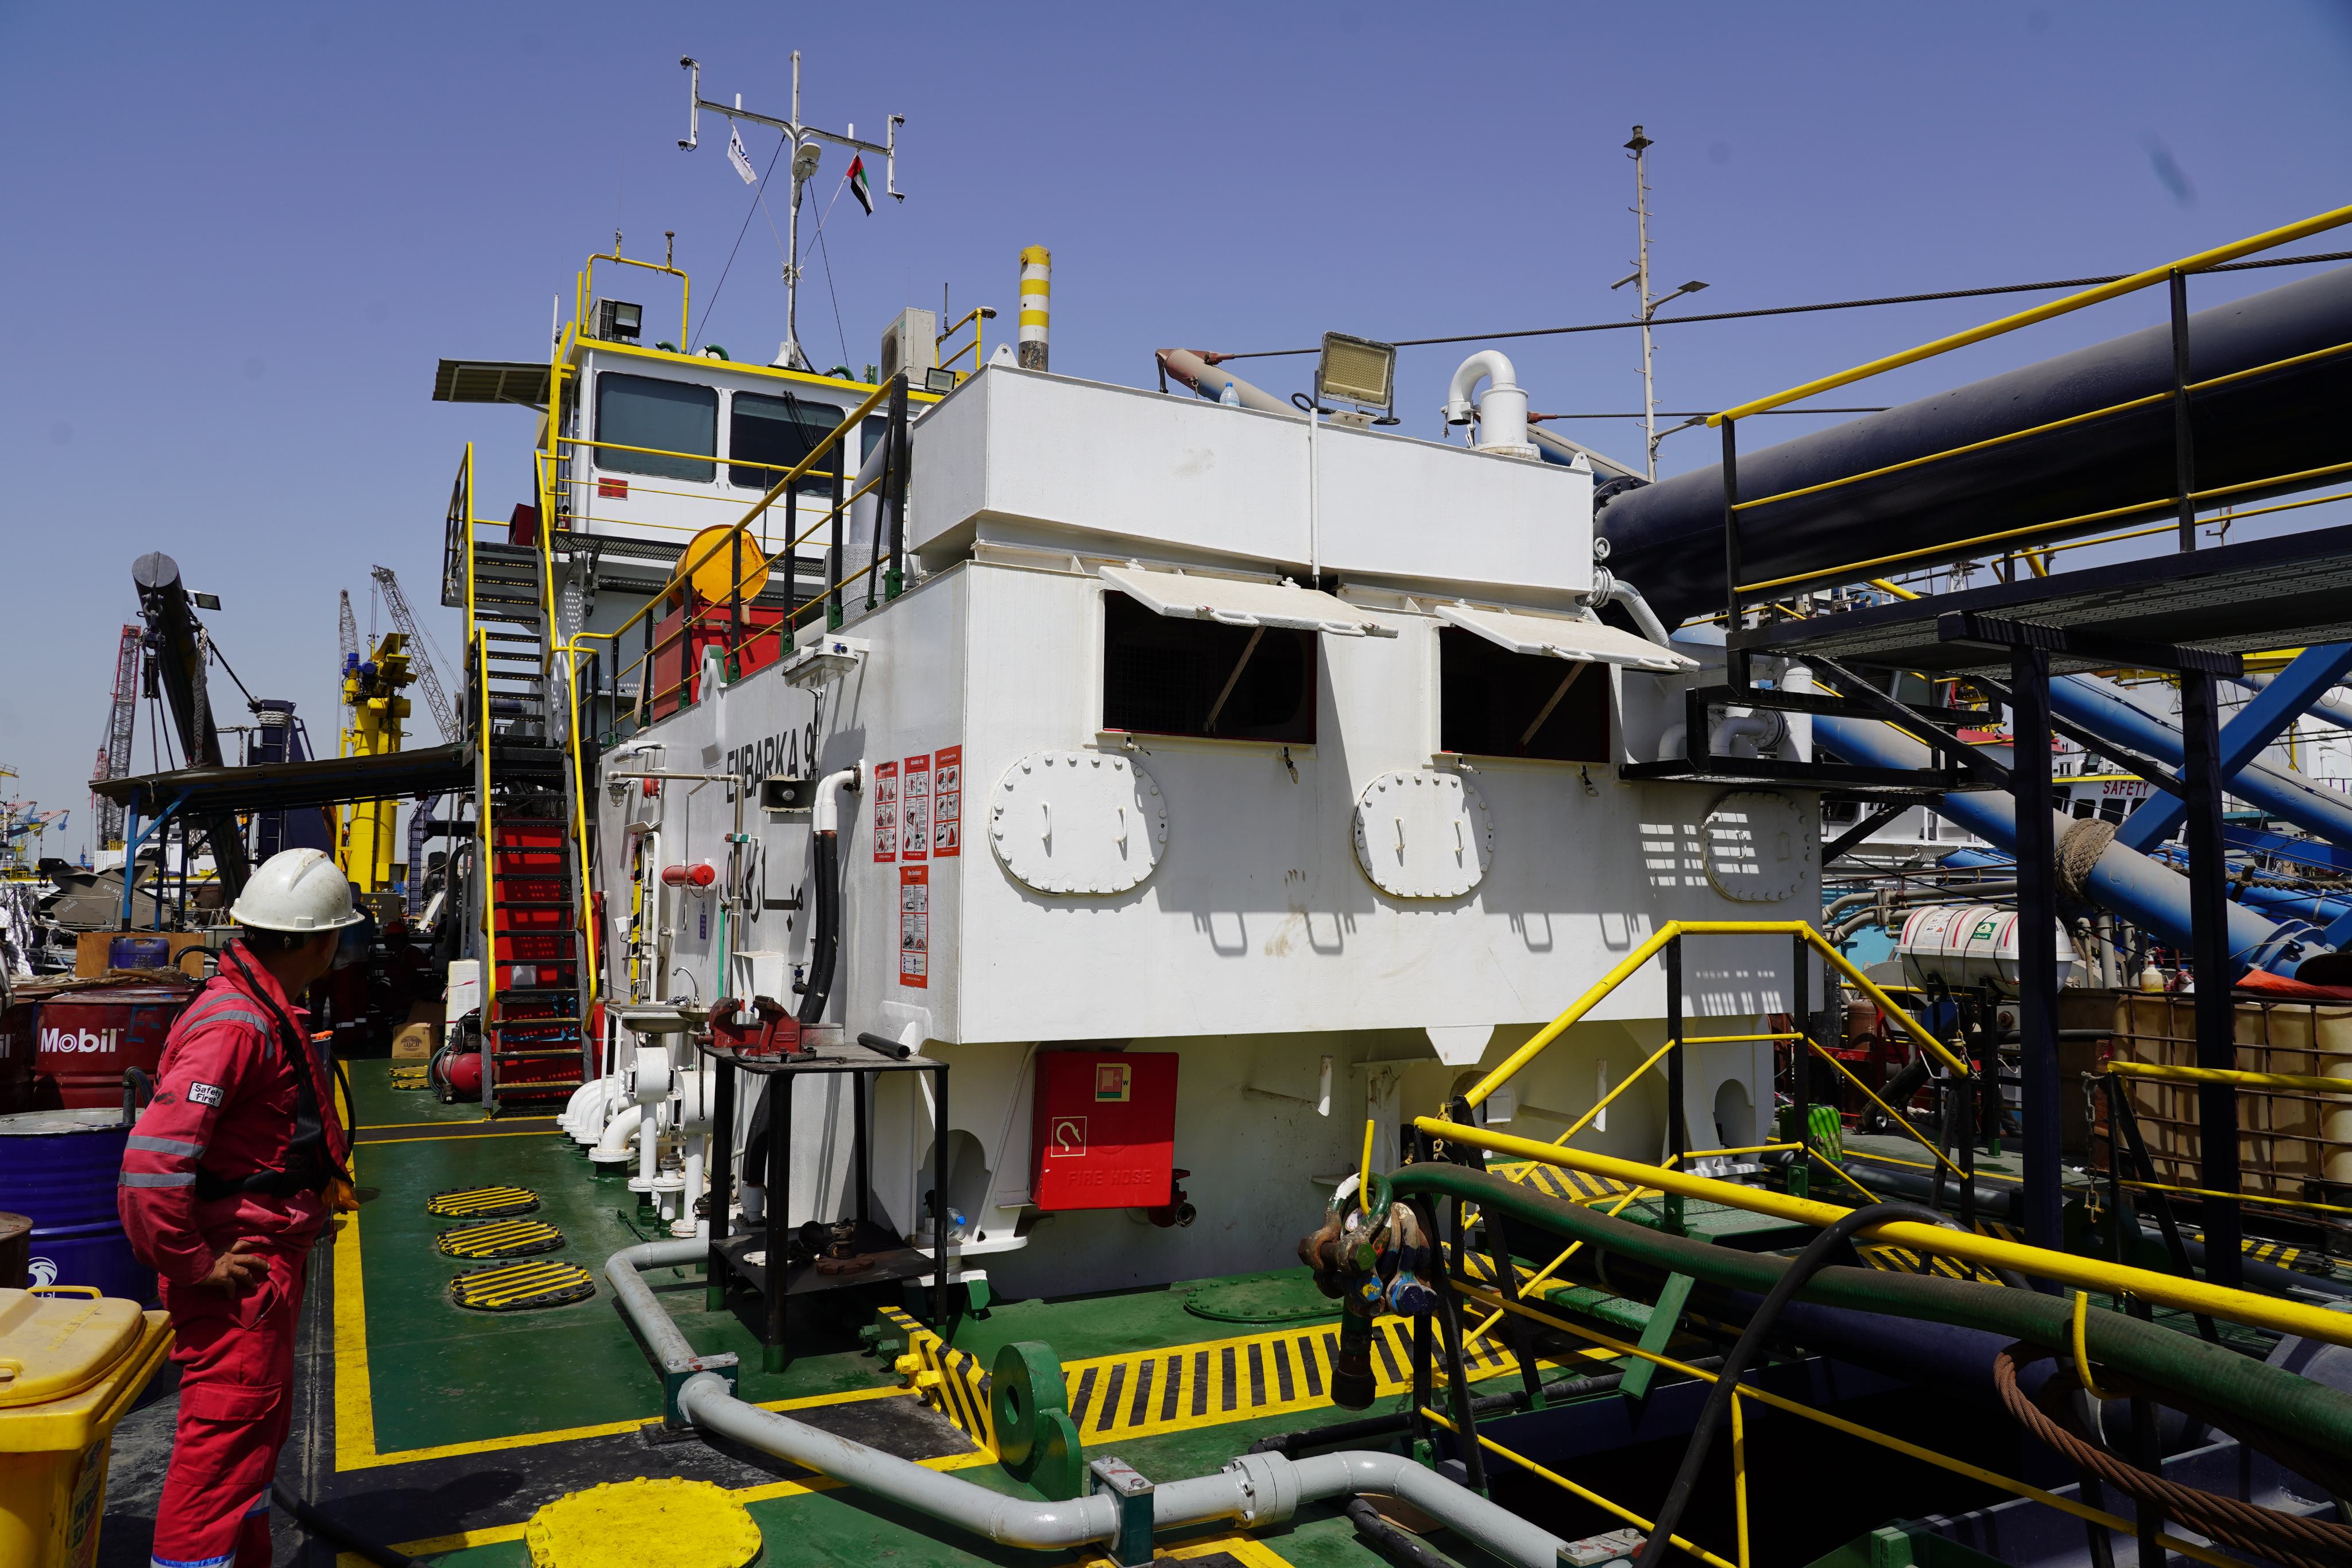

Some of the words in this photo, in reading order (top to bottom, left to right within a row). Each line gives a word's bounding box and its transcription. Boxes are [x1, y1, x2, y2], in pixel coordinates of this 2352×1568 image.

[727, 729, 799, 804] EMBARKA
[804, 722, 815, 780] 9
[2103, 780, 2150, 796] SAFETY
[40, 1028, 117, 1053] Mobil
[195, 1085, 222, 1098] Safety
[196, 1093, 216, 1104] First
[1067, 1170, 1103, 1187] FIRE
[1111, 1169, 1152, 1186] HOSE
